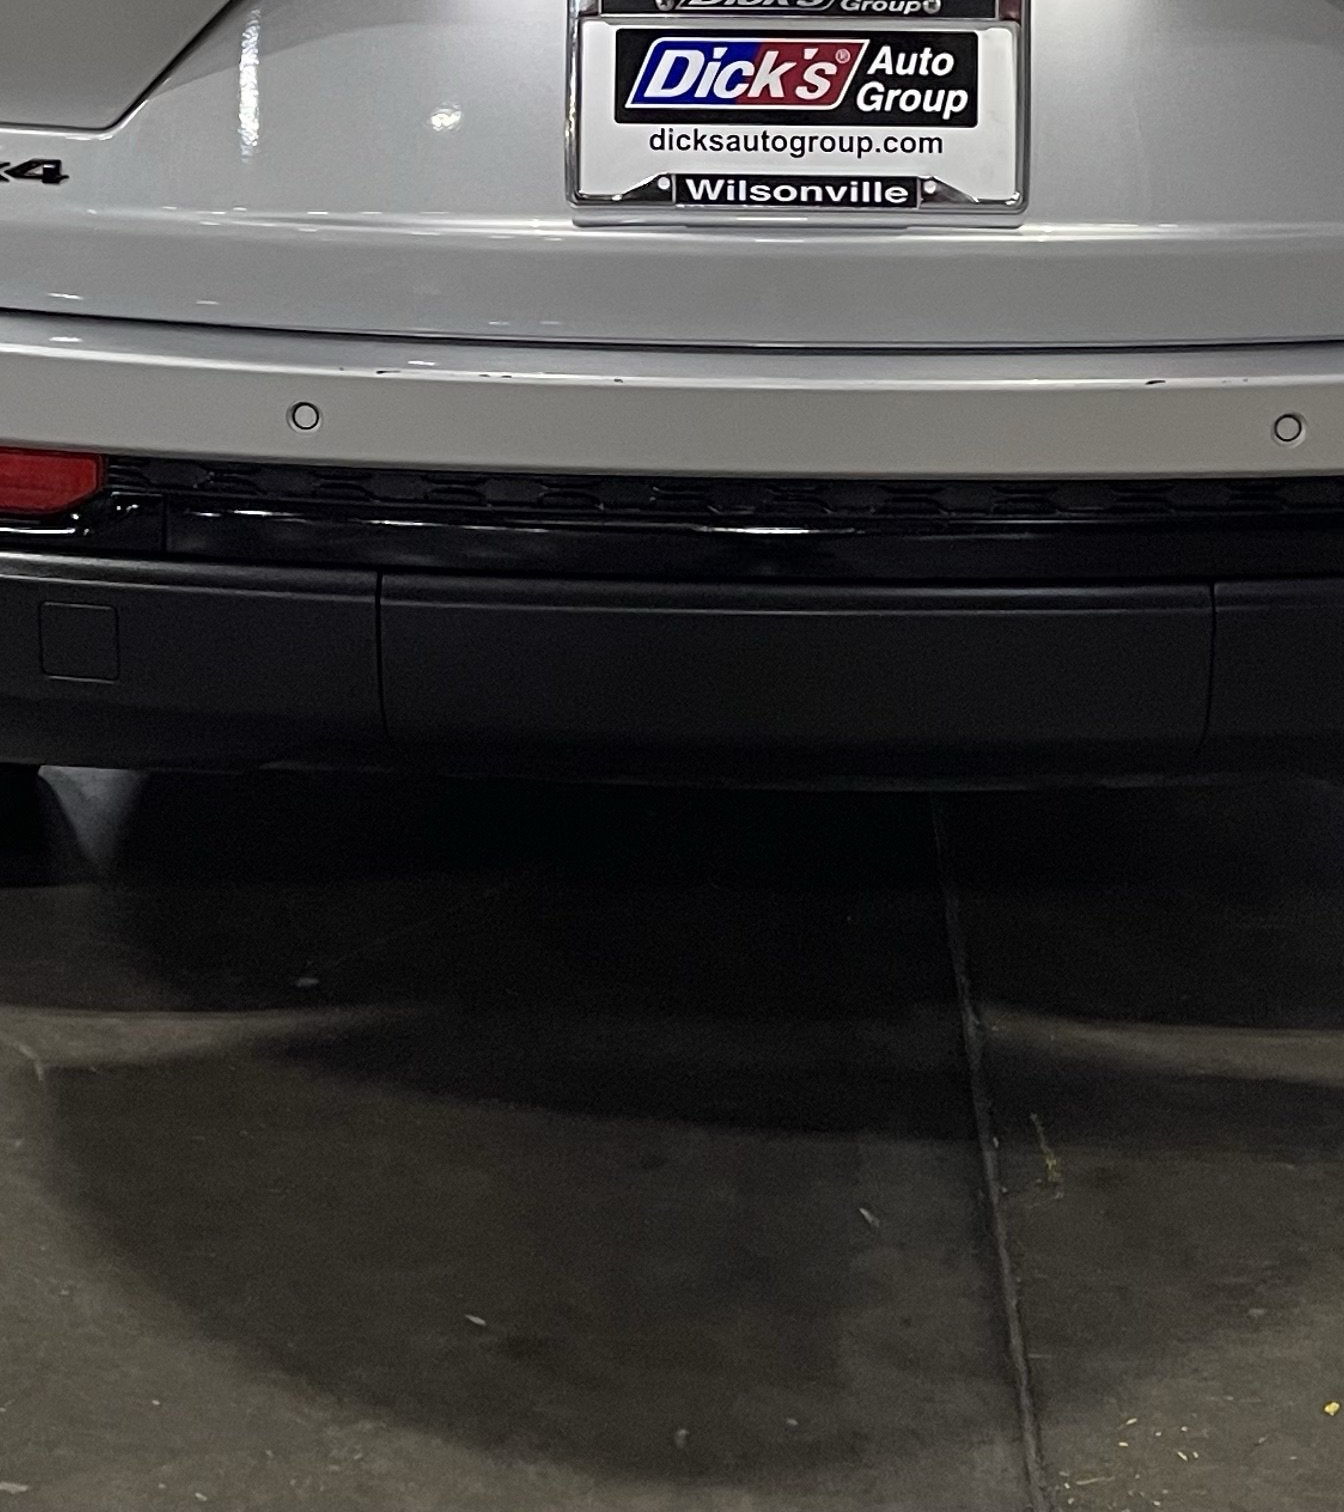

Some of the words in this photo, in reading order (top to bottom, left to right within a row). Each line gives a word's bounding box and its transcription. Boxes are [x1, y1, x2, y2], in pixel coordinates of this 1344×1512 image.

[643, 47, 837, 101] Dick's
[866, 45, 955, 76] Auto
[856, 82, 969, 120] Group
[649, 128, 944, 159] dicksautogroup.com
[685, 179, 910, 204] Wilsonville
